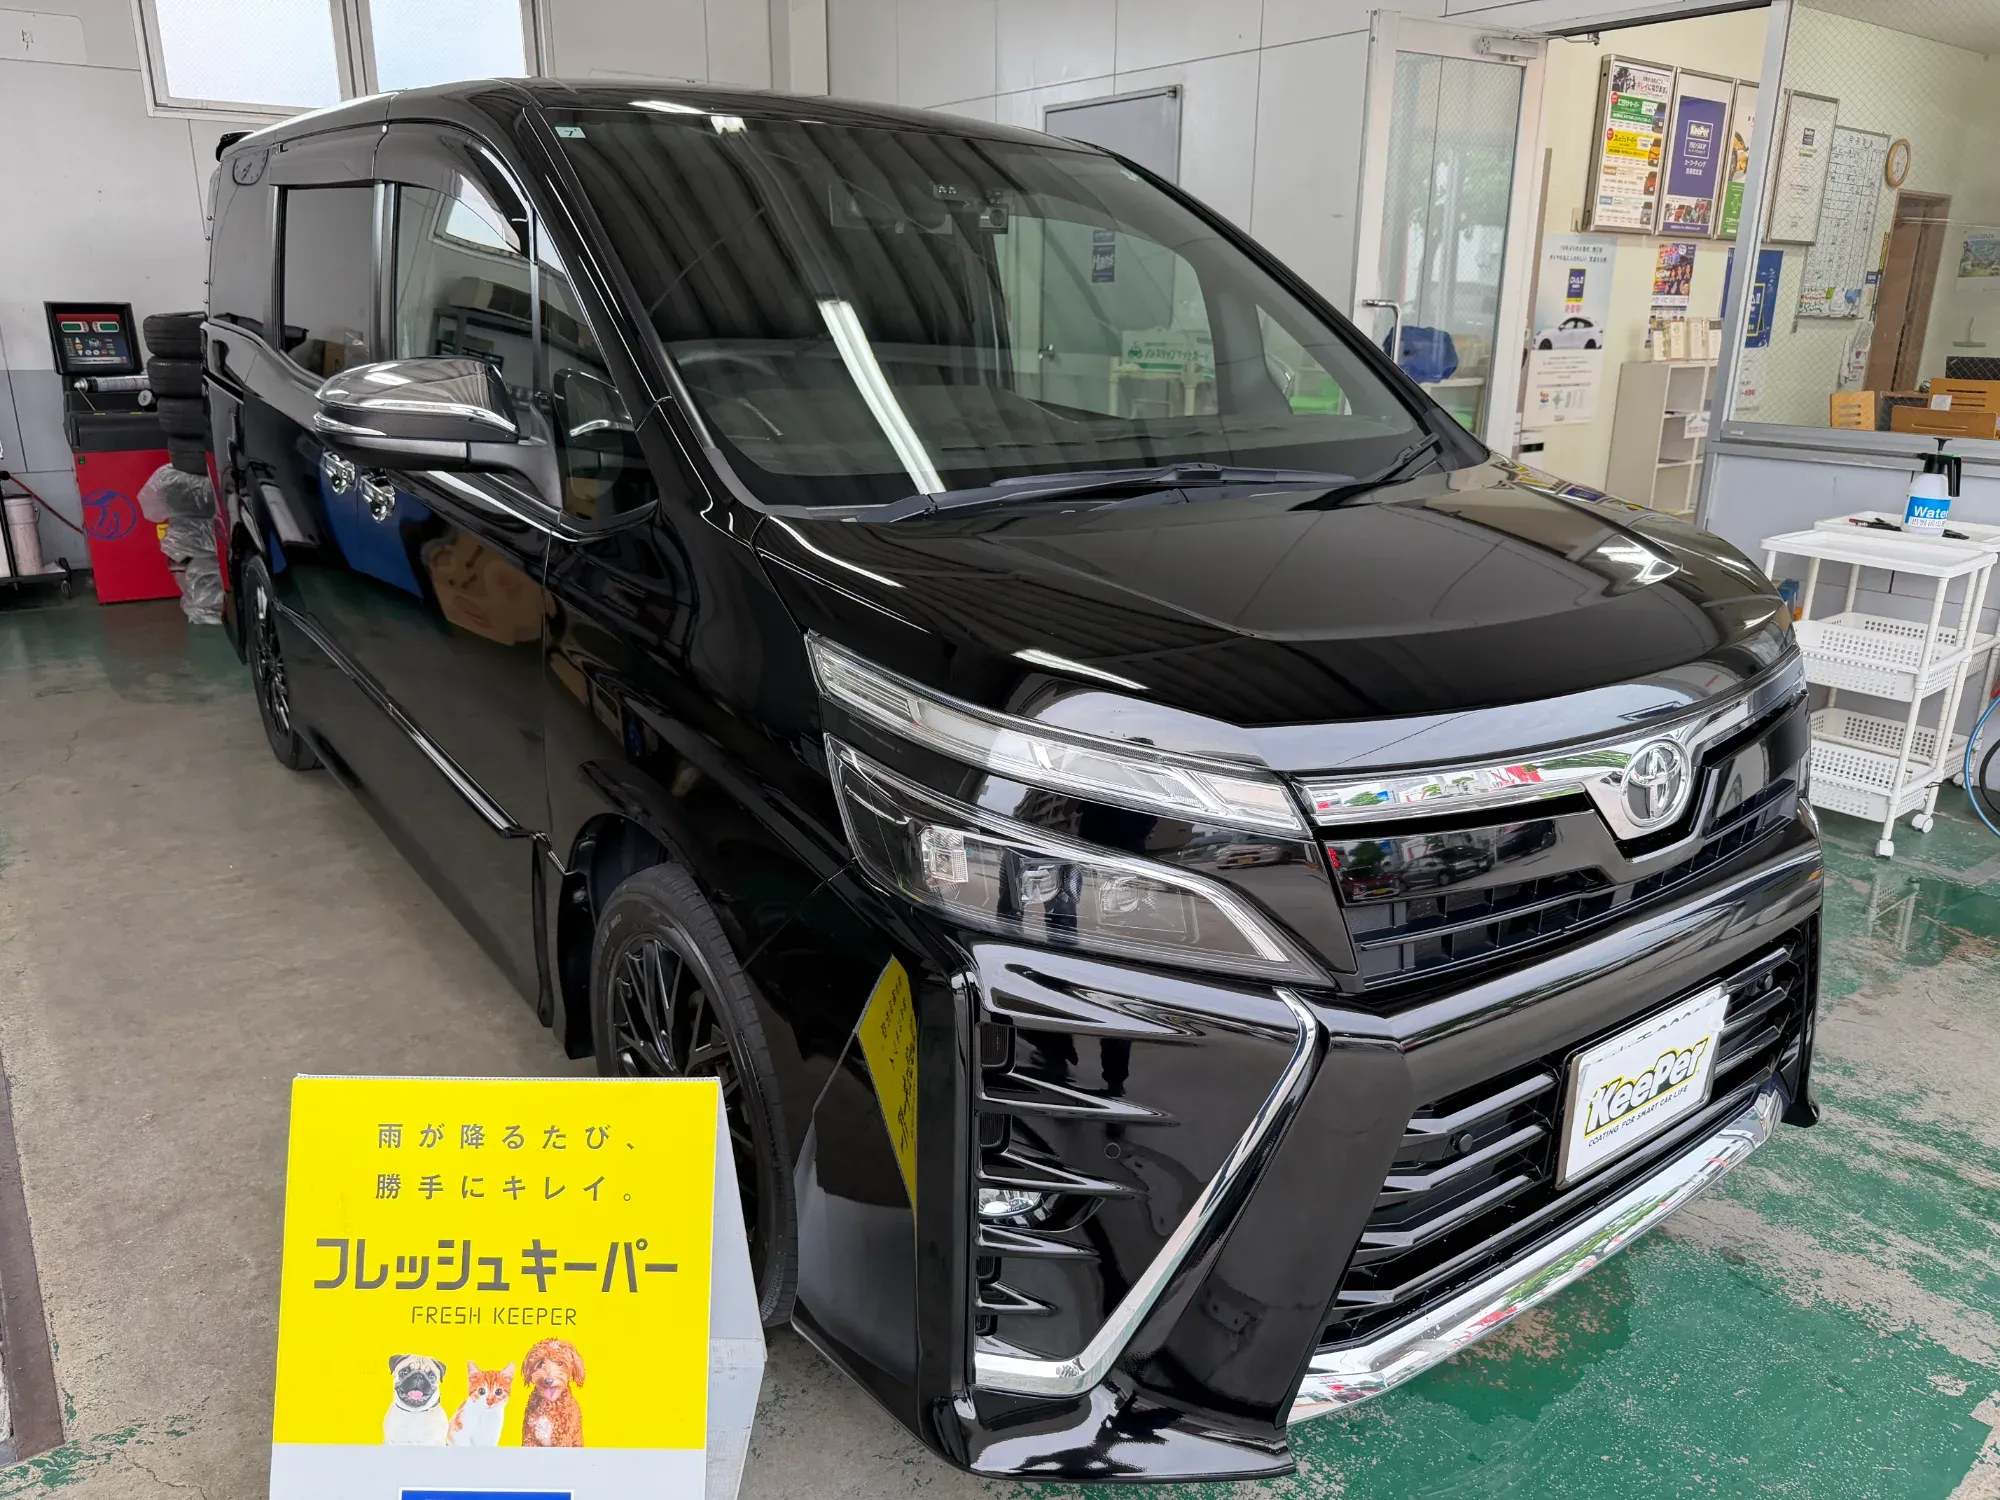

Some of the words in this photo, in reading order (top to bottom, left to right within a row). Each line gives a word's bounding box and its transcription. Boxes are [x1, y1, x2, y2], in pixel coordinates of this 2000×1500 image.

[1584, 1034, 1711, 1138] KeePer
[377, 1122, 639, 1151] 雨が降るたび、
[1588, 1125, 1619, 1147] COATING
[1621, 1116, 1636, 1129] FOR
[1637, 1103, 1659, 1120] SMART
[1660, 1095, 1673, 1107] CAR
[1673, 1085, 1689, 1098] LIFE
[375, 1172, 632, 1202] 勝手にキレイ。
[313, 1237, 679, 1293] フレッシュキーパー
[411, 1305, 482, 1325] FRESH
[493, 1306, 578, 1326] KEEPER
